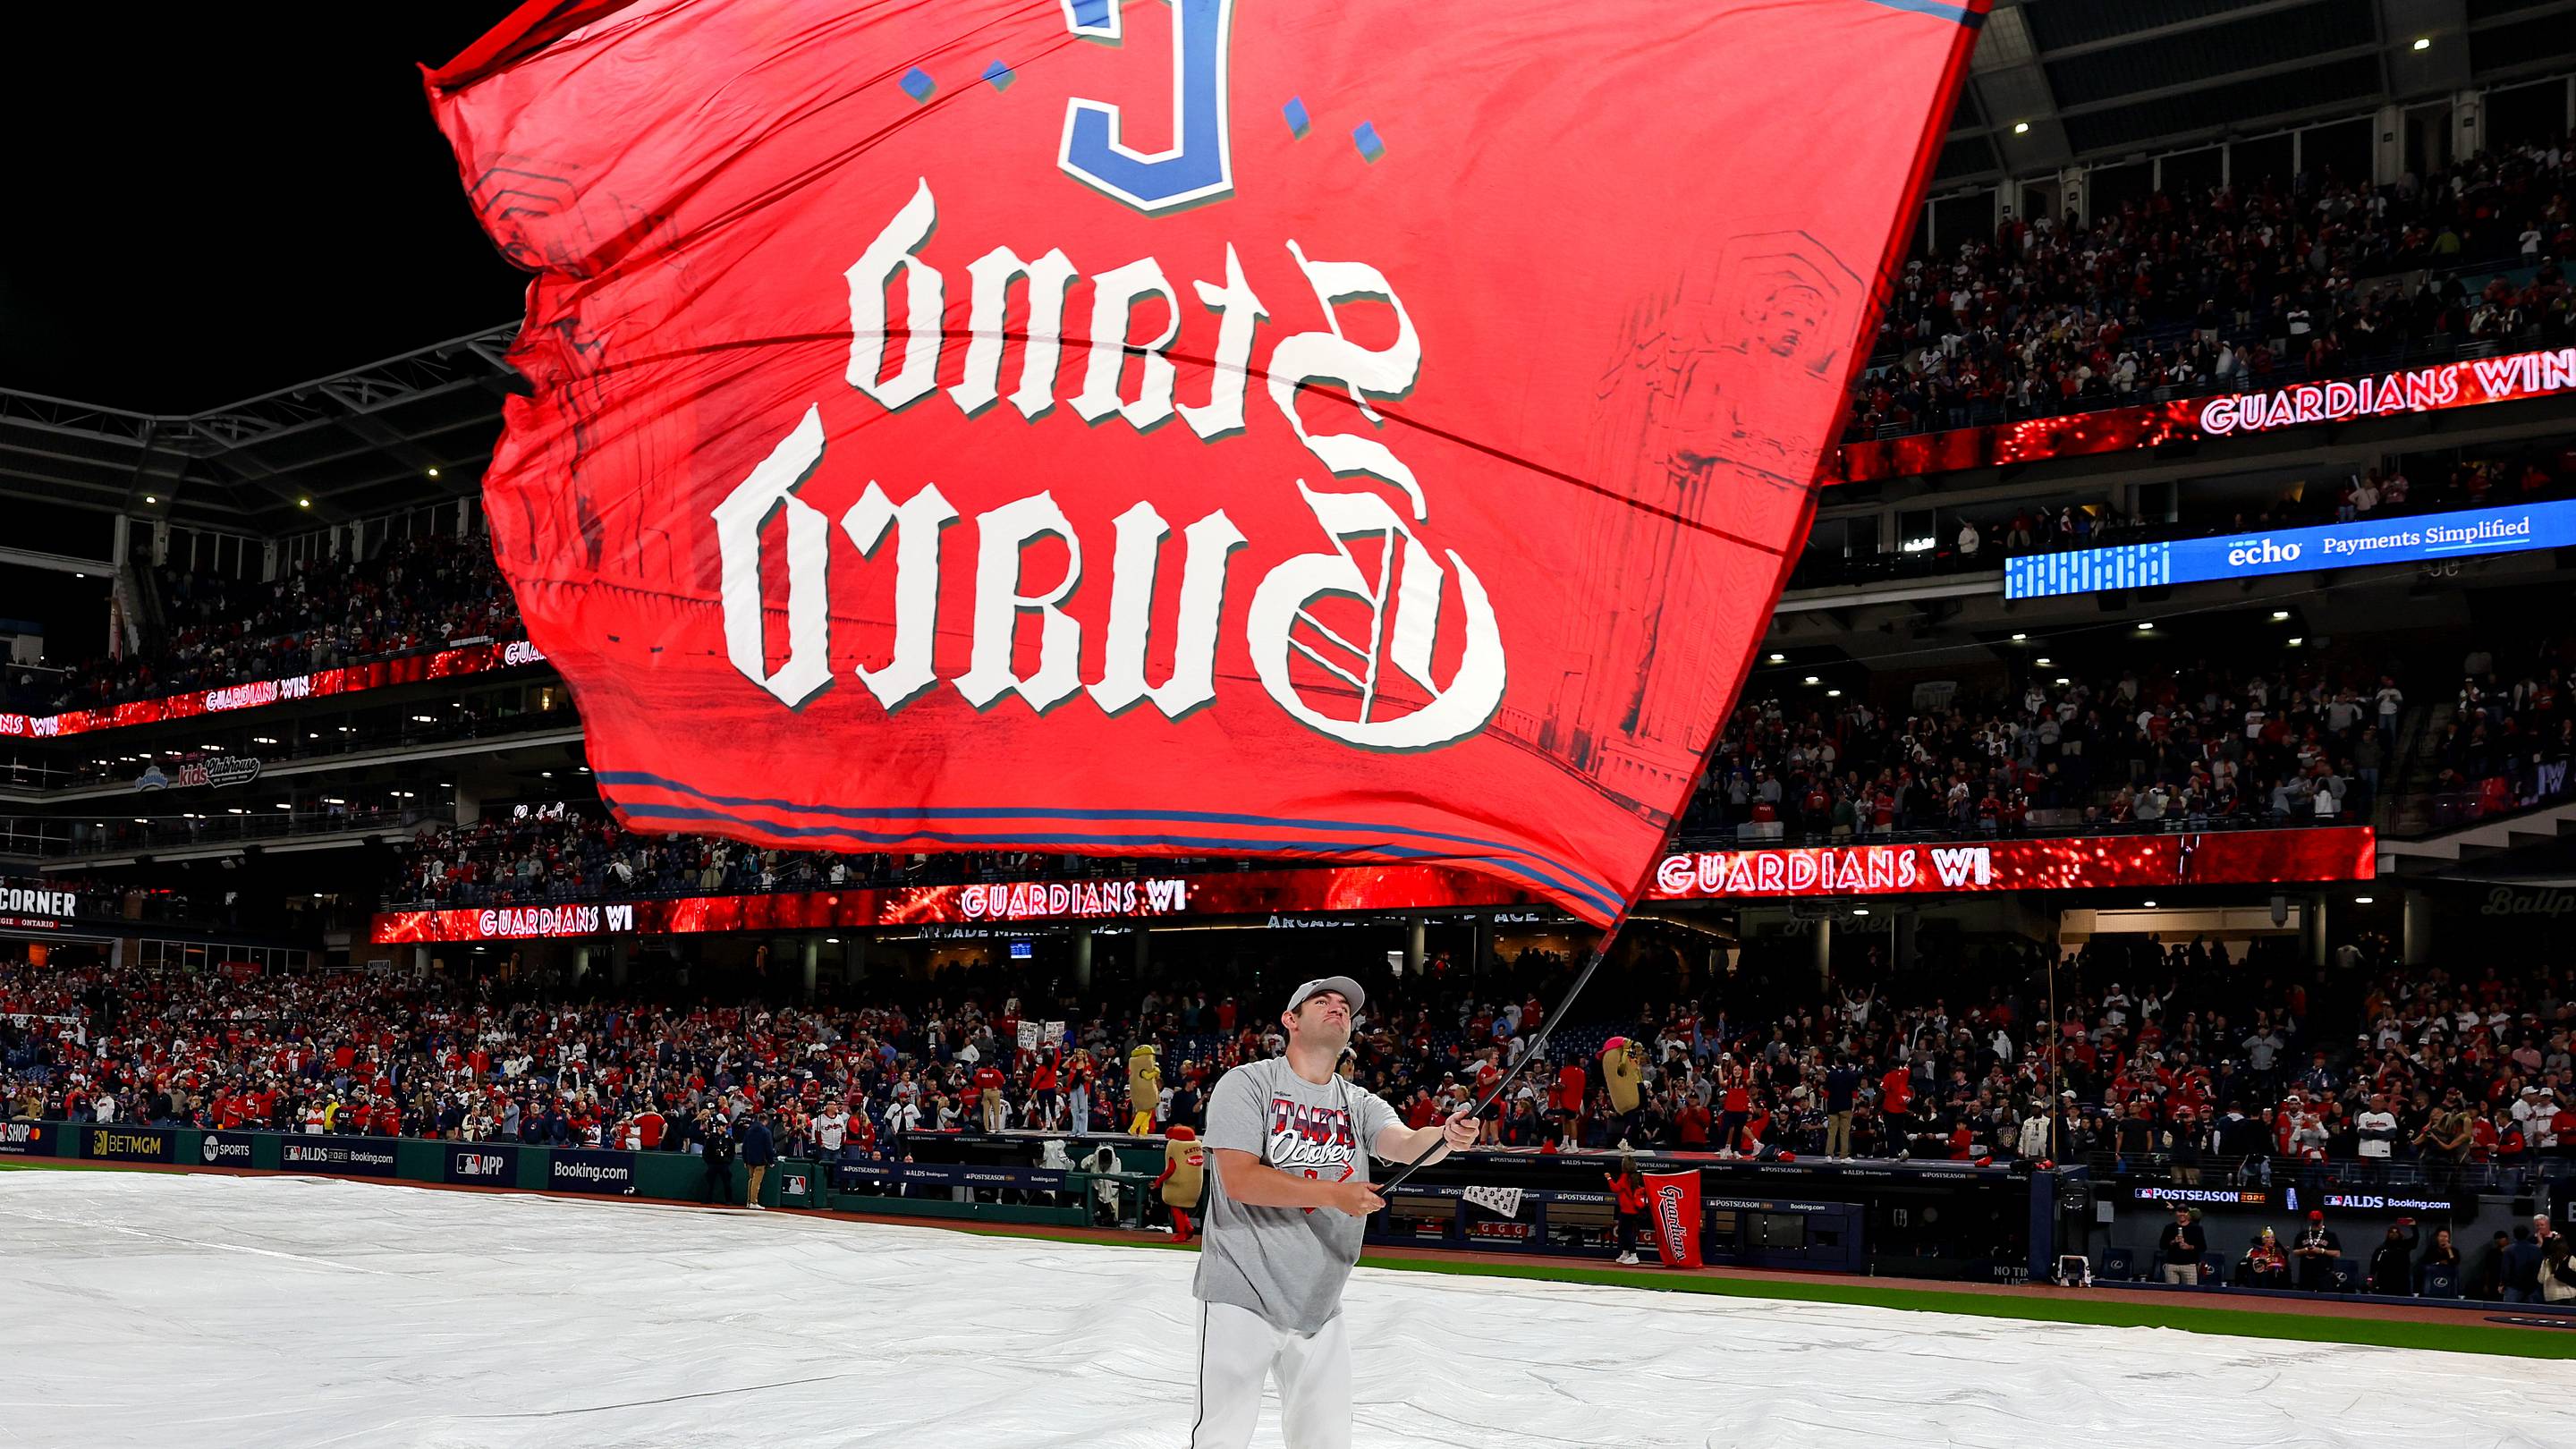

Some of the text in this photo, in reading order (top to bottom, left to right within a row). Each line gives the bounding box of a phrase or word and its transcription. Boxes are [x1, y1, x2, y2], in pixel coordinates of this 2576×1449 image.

[2200, 348, 2576, 436] GUARDIANS WIN
[2228, 516, 2530, 567] echo Payments Simplified
[205, 674, 309, 712] GUARDIANS WIN
[30, 716, 59, 737] WIN
[179, 763, 208, 787] kids
[205, 757, 258, 775] Clubhouse
[1657, 848, 1917, 894] GUARDIANS
[0, 887, 76, 917] CORNER
[961, 881, 1136, 918] GUARDIANS
[21, 919, 54, 928] ONTARIO
[479, 905, 598, 936] GUARDIANS
[7, 1123, 30, 1142] SHOP
[109, 1135, 161, 1154] BETMGM
[219, 1145, 250, 1157] SPORTS
[1270, 1128, 1356, 1165] October
[301, 1148, 328, 1162] ALDS
[351, 1151, 394, 1165] Booking.com
[481, 1157, 504, 1175] APP
[555, 1161, 628, 1182] Booking.com
[848, 1165, 880, 1174] POSTSEASON
[1563, 1193, 1604, 1201] POSTSEASON
[1716, 1200, 1759, 1208] POSTSEASON
[2152, 1188, 2239, 1202] POSTSEASON
[2343, 1195, 2451, 1210] ALDS Booking.com
[1790, 1203, 1826, 1211] Booking.com
[1657, 1185, 1687, 1262] Guardians
[1994, 1266, 2011, 1276] NO
